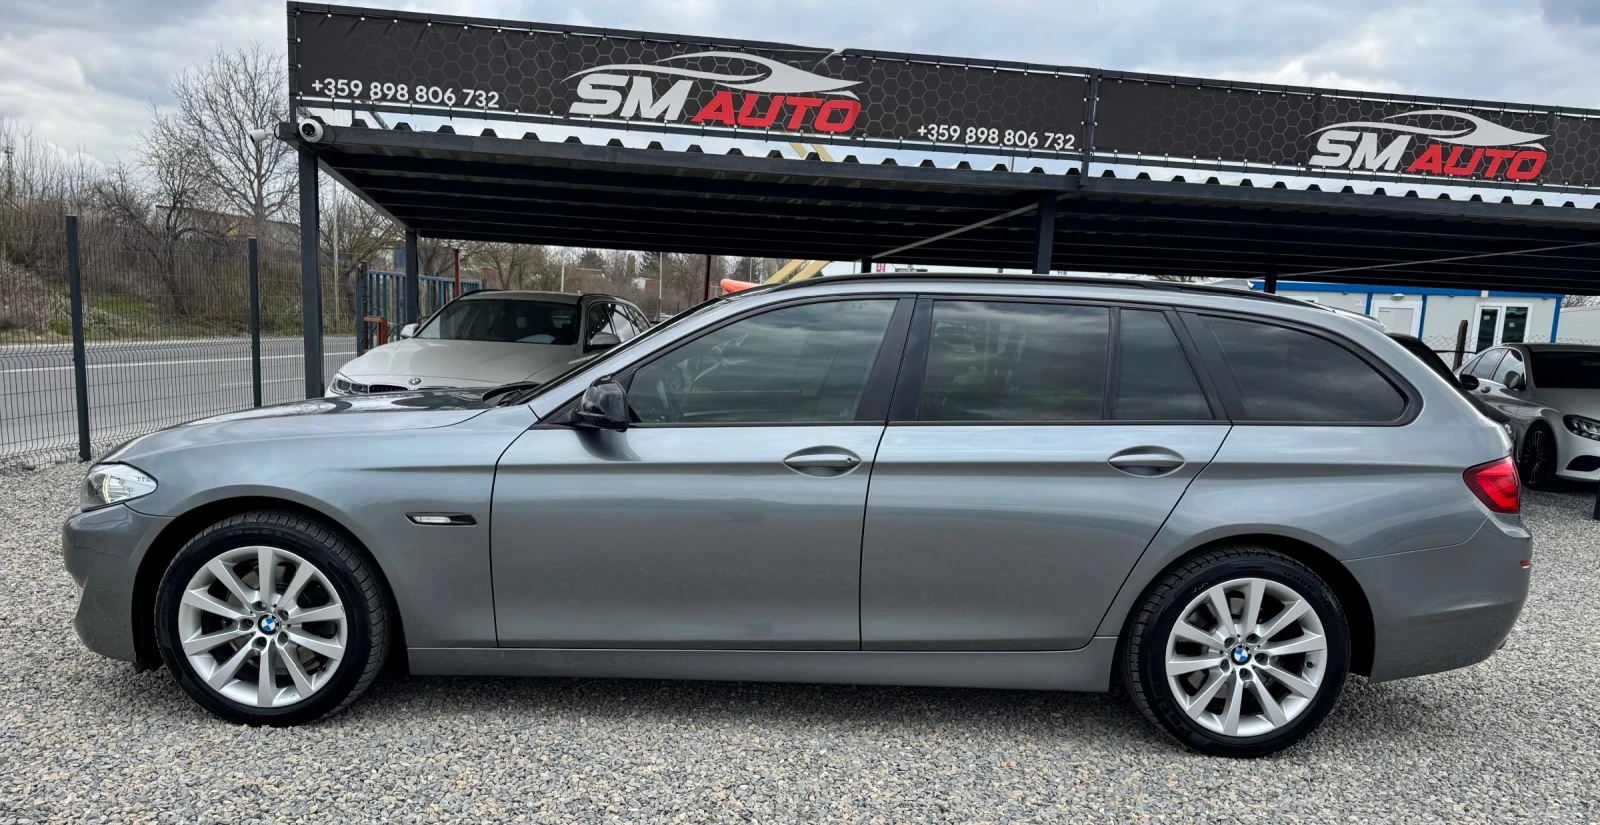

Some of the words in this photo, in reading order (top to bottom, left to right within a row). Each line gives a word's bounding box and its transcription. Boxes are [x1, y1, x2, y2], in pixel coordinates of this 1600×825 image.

[311, 78, 363, 97] +359
[369, 81, 409, 101] 898
[415, 85, 456, 106] 806
[462, 88, 500, 108] 732
[568, 73, 694, 121] SM
[690, 90, 862, 133] AUTO
[917, 124, 961, 141] +359
[965, 126, 999, 144] 898
[1003, 129, 1038, 147] 806
[1043, 132, 1076, 150] 732
[1308, 129, 1412, 171] SM
[1405, 144, 1548, 180] AUTO
